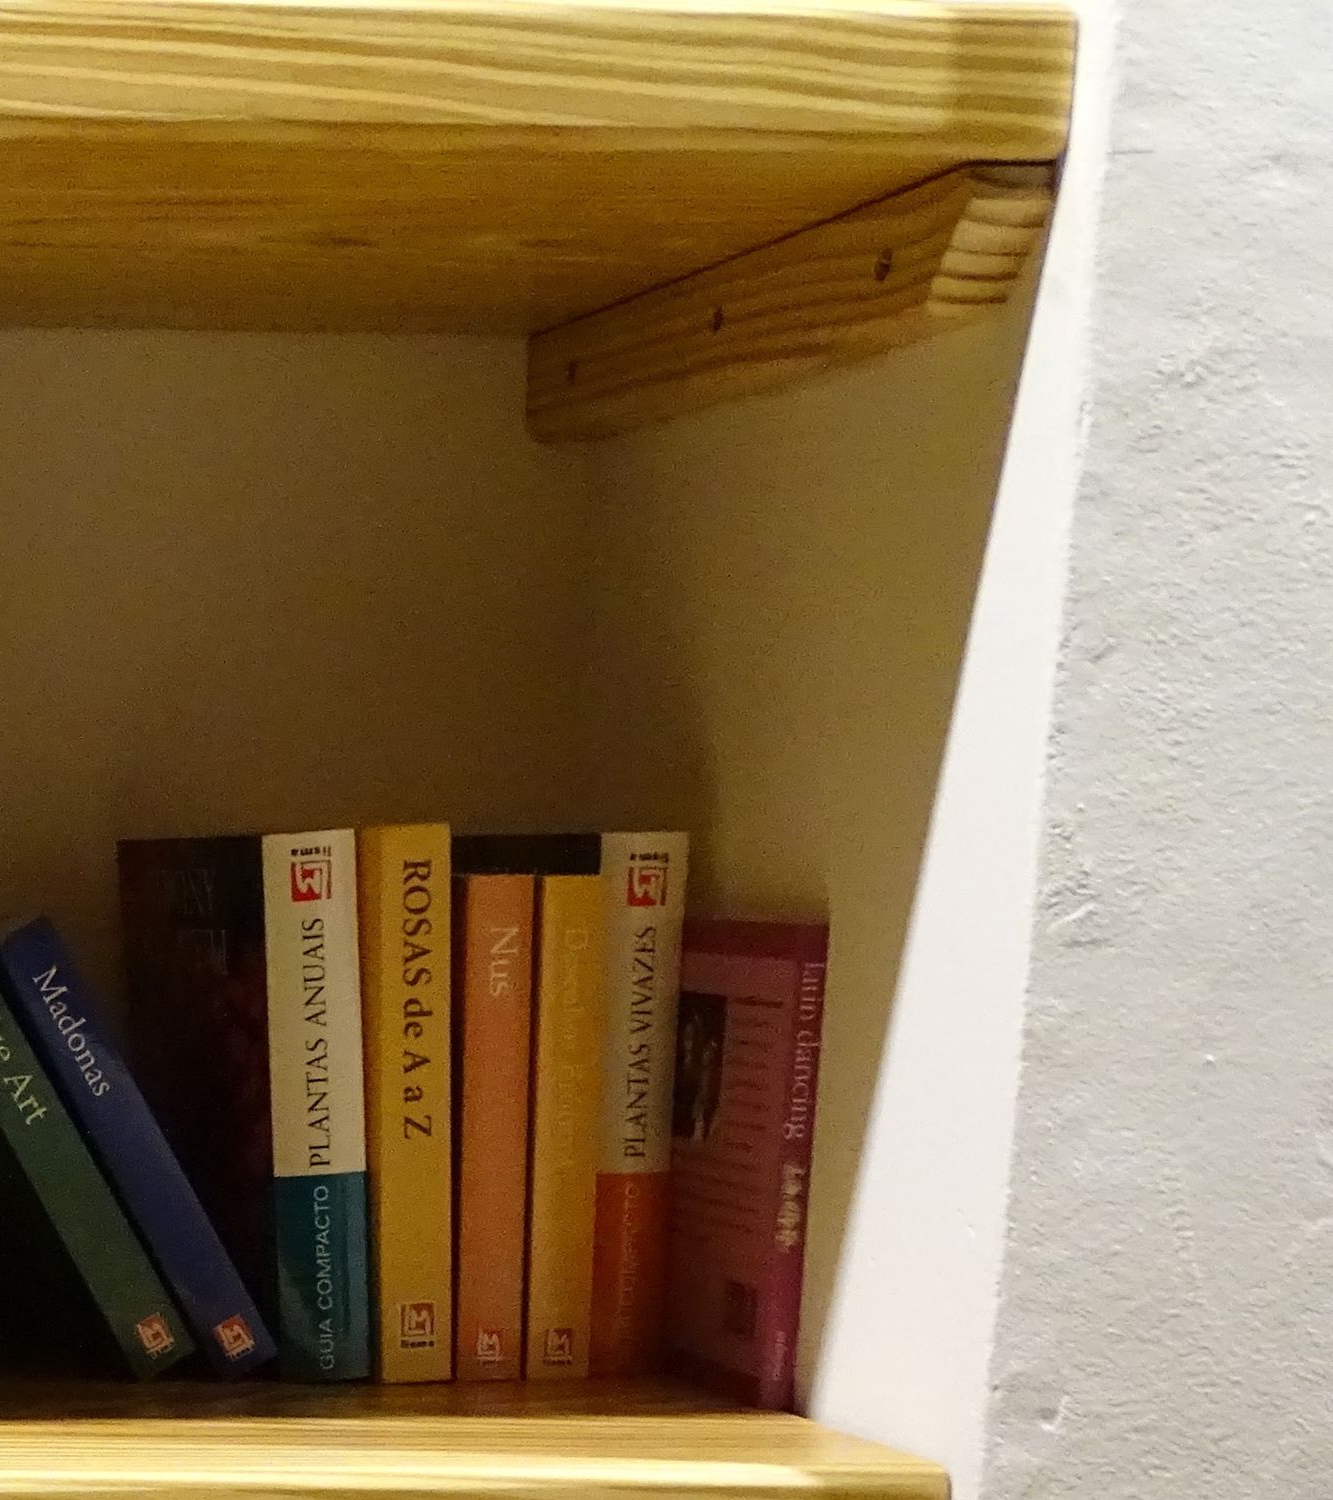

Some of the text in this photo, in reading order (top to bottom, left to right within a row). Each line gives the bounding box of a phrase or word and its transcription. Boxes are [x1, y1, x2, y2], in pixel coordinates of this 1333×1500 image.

[402, 859, 435, 1140] ROSAS de A a Z
[488, 927, 518, 997] Nus
[631, 925, 657, 1038] VIVAZES
[802, 959, 826, 1036] latin
[31, 962, 112, 1101] Madonas
[303, 917, 332, 1169] PLANTAS ANUAIS
[2, 1066, 49, 1127] Art
[623, 1046, 648, 1159] PLANTAS
[781, 1042, 823, 1141] dancing
[314, 1184, 334, 1370] GUIA COMPACTO
